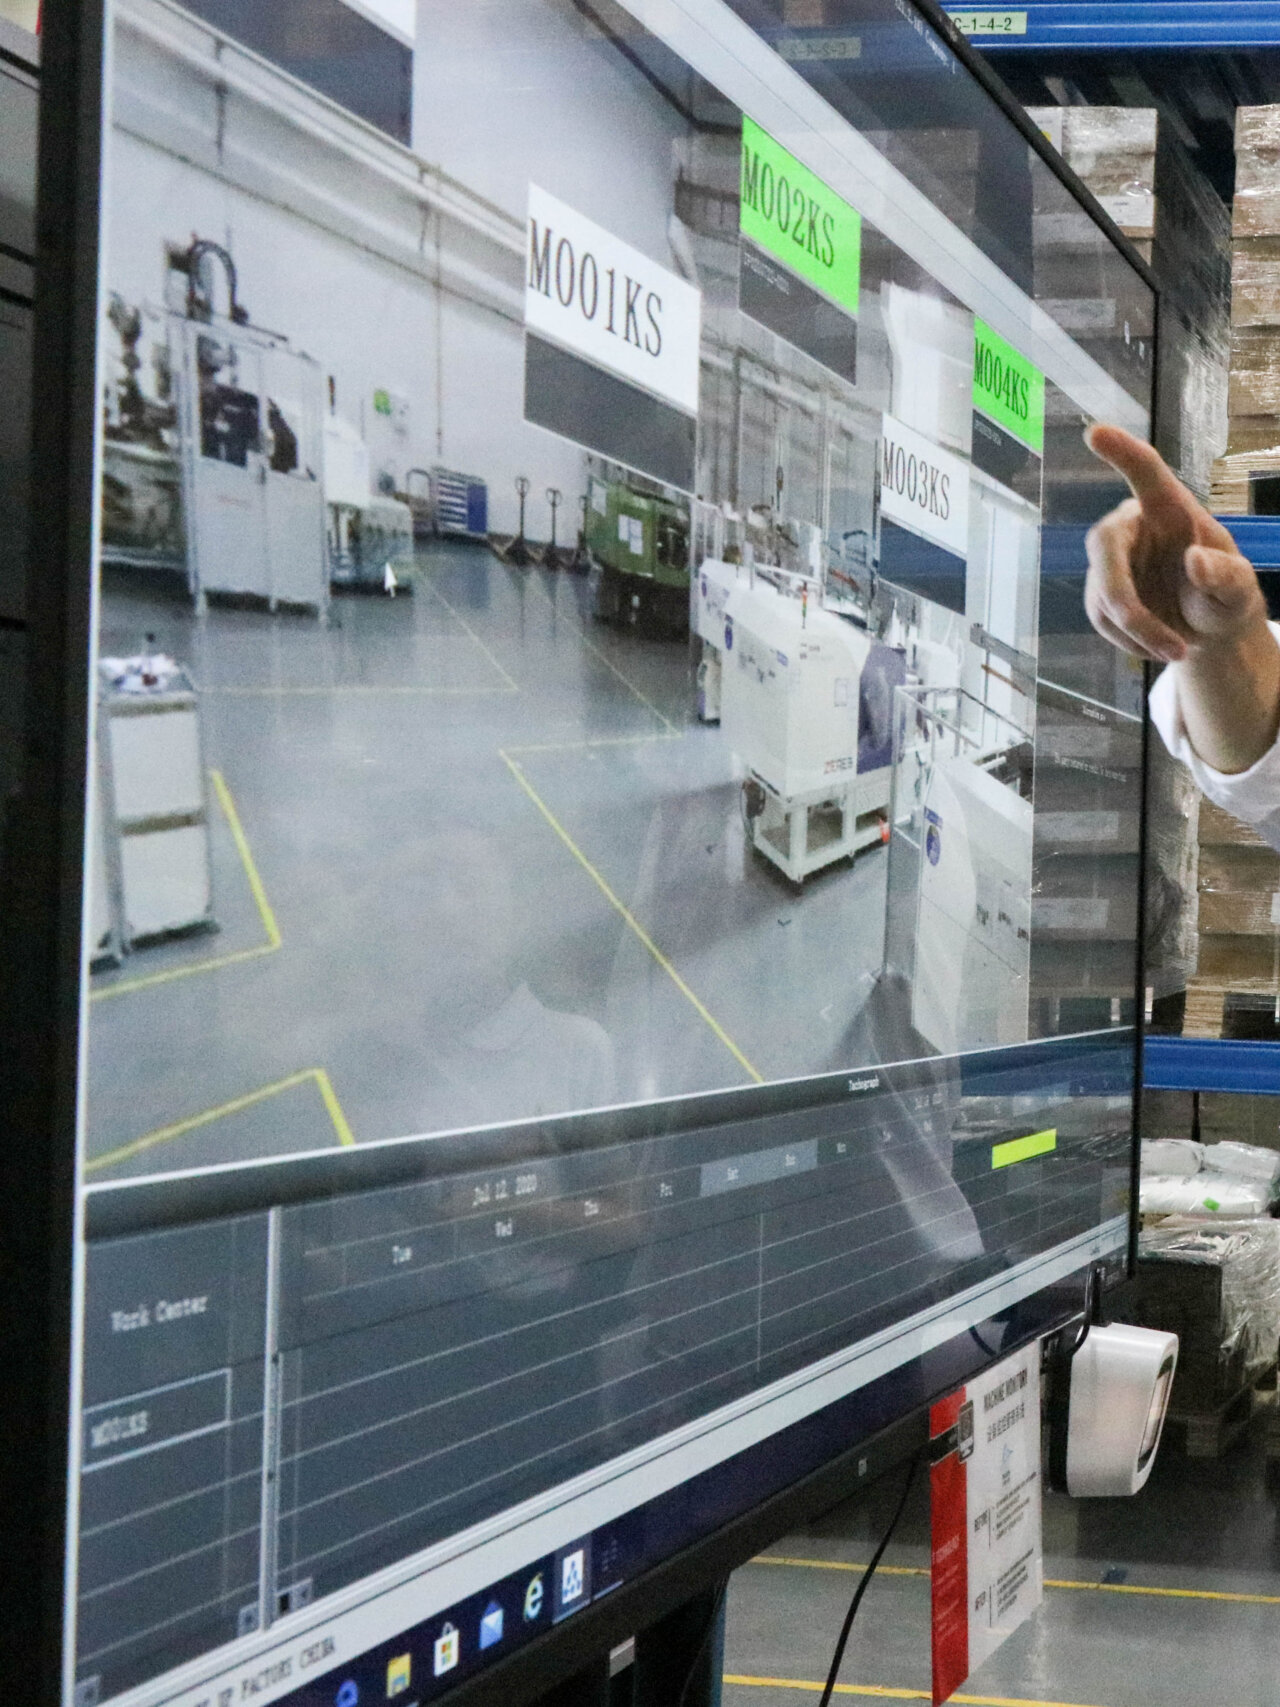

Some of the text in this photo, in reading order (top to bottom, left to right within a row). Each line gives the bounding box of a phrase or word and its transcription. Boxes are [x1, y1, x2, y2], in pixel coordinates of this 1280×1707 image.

[954, 17, 1012, 31] C-1-4-2
[742, 143, 835, 268] M002KS
[528, 217, 663, 357] M001KS
[973, 337, 1029, 421] M004KS
[882, 436, 950, 521] M003KS
[111, 1297, 208, 1332] Work Center
